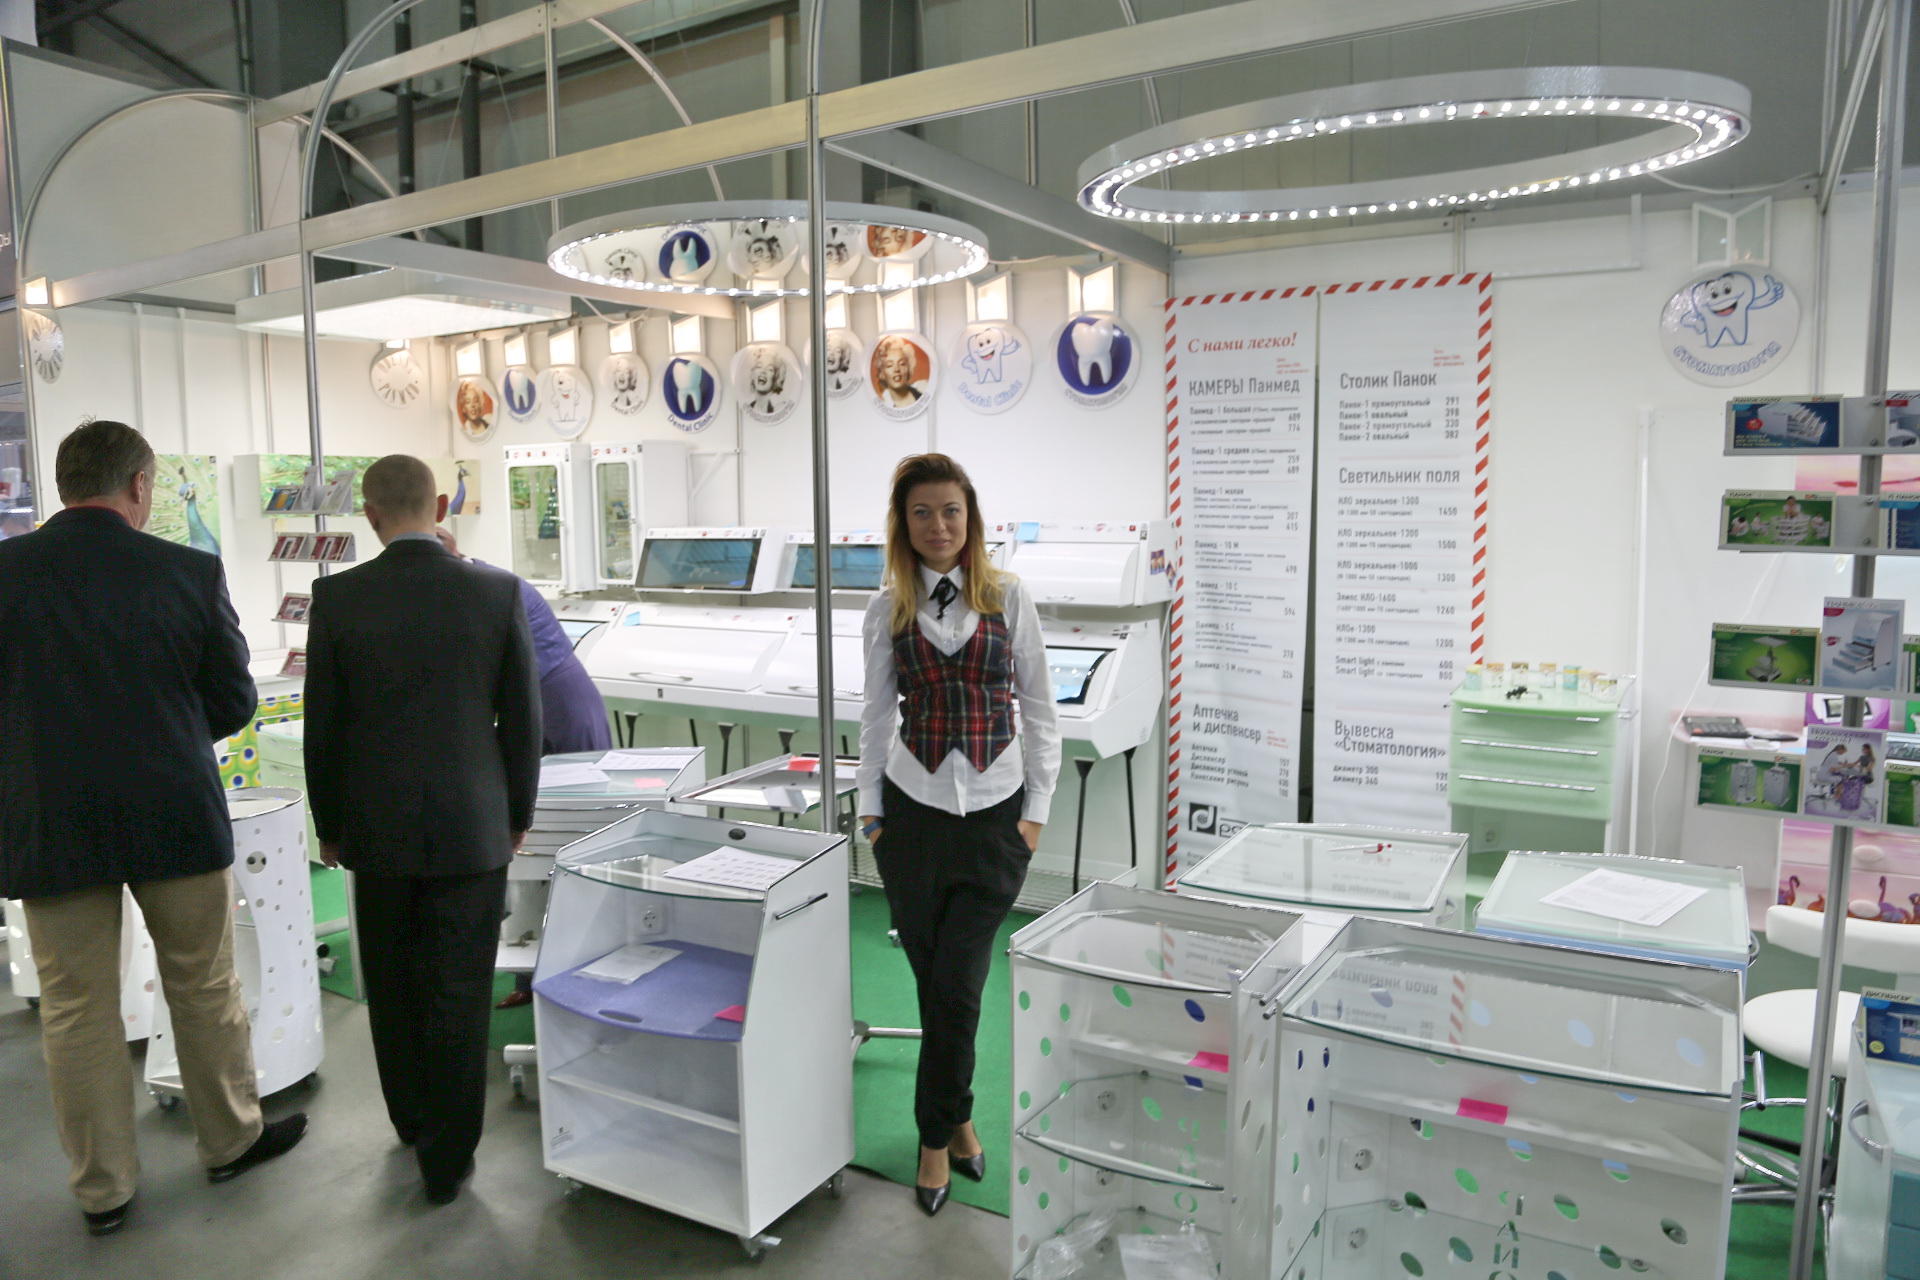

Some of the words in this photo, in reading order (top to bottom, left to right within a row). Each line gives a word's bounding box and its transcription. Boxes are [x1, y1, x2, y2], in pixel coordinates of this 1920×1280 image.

[1203, 340, 1244, 352] нами
[1248, 332, 1297, 350] легко!
[1189, 378, 1243, 396] КАМЕРЫ
[1249, 378, 1300, 394] Панмед
[1340, 372, 1388, 389] Столик
[1393, 371, 1437, 387] Панок
[667, 414, 692, 432] Dental
[694, 412, 713, 431] Clinic
[1340, 467, 1421, 484] Светильник
[1426, 470, 1460, 483] поля
[1336, 656, 1356, 664] Smart
[1359, 657, 1375, 666] light
[1336, 666, 1356, 675] Smart
[1359, 667, 1375, 677] light
[1194, 704, 1239, 722] Аптечка
[1193, 722, 1200, 732] и
[1204, 723, 1260, 744] диспенсер
[1335, 720, 1393, 739] Вывеска
[1335, 736, 1446, 758] «Стоматология»
